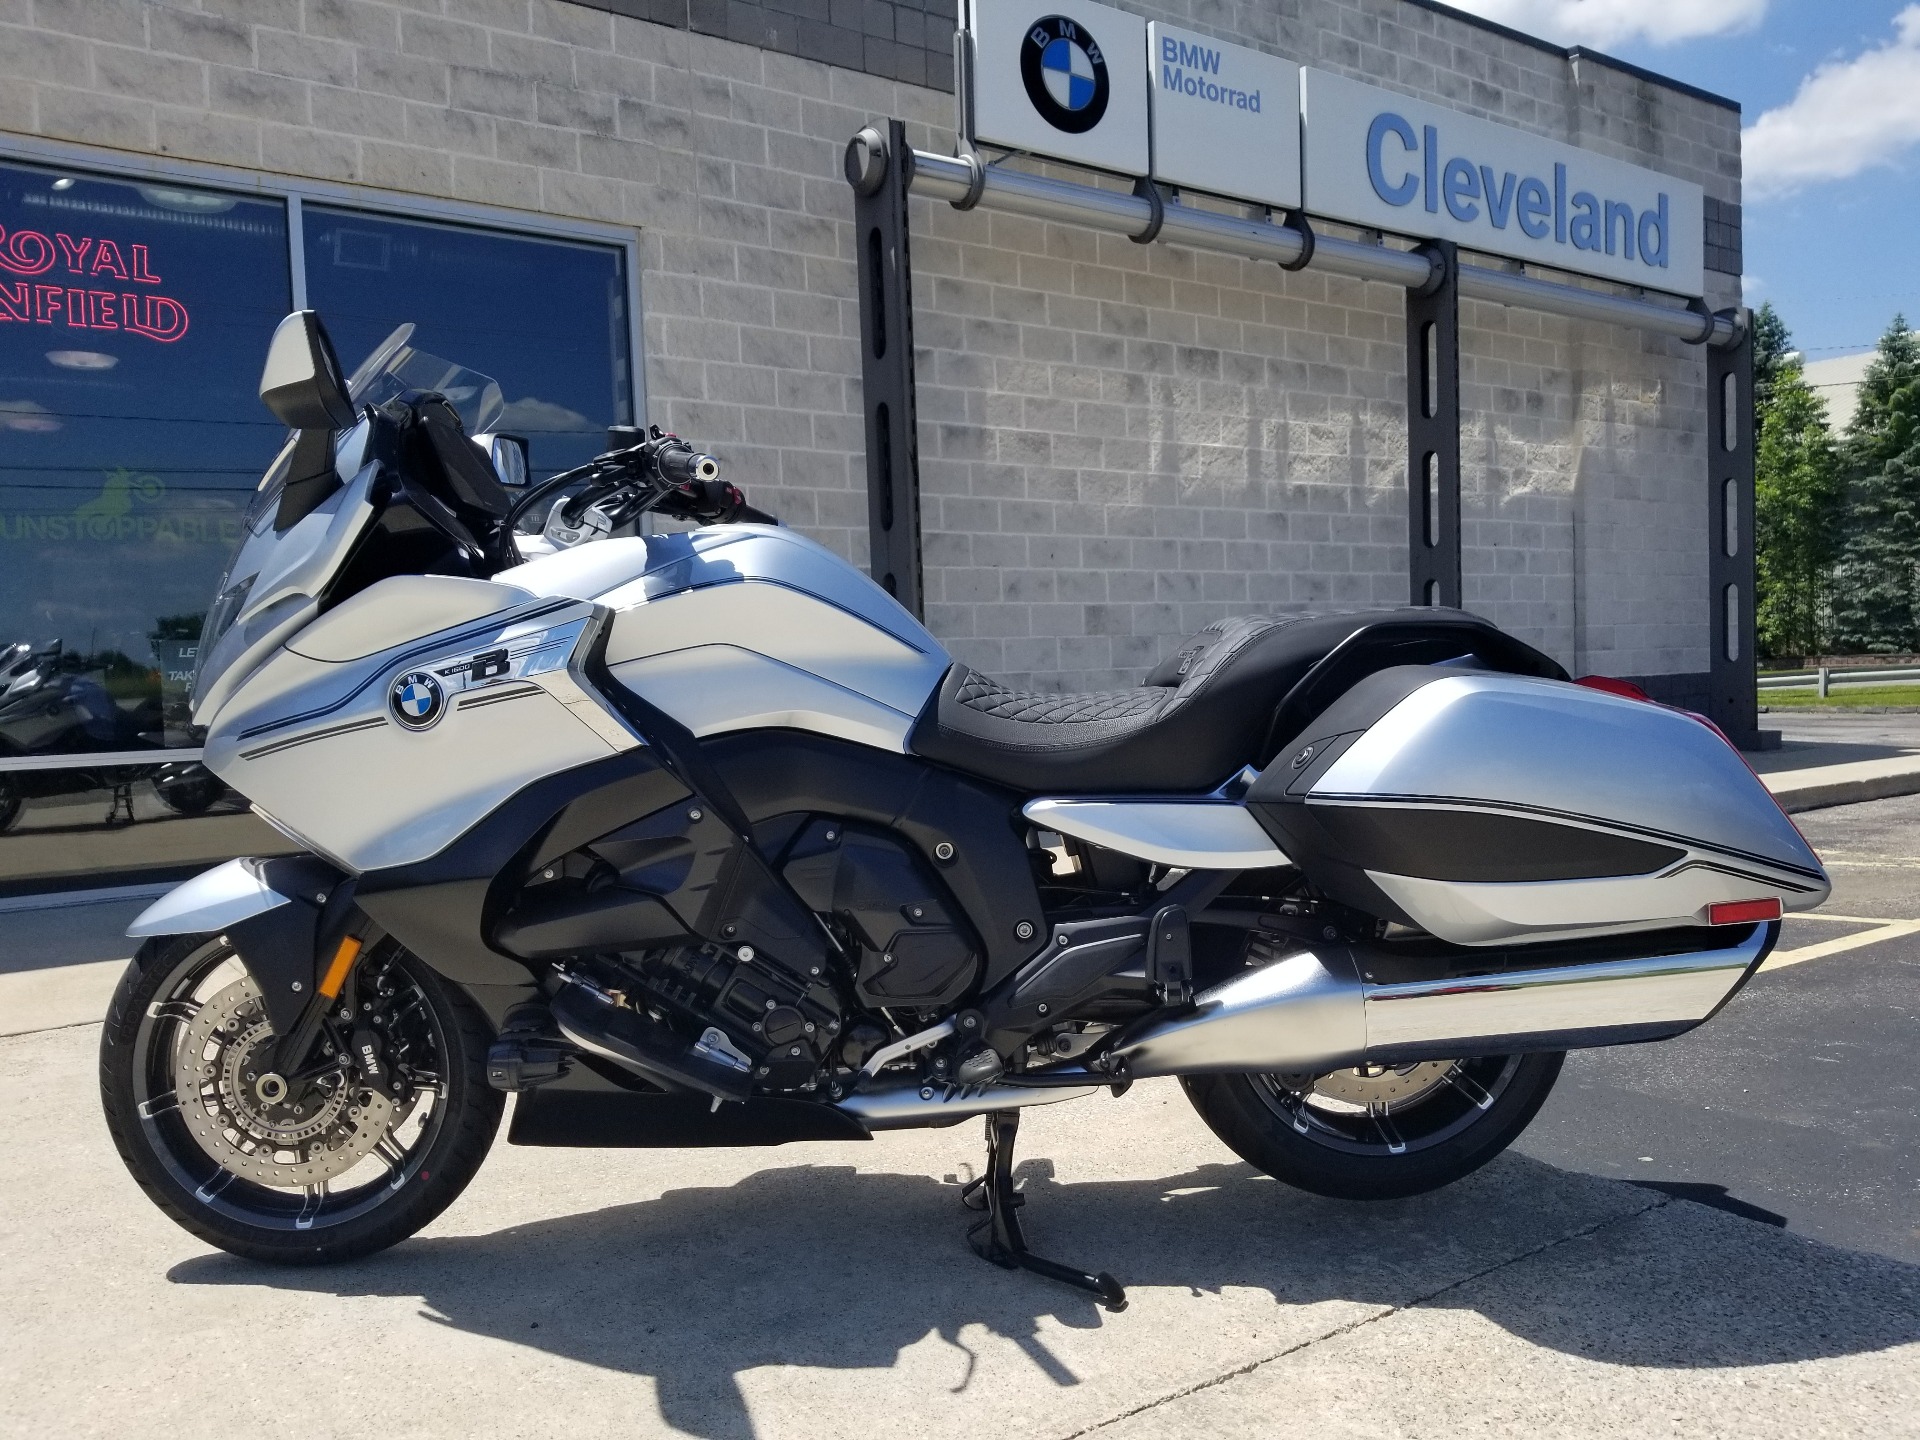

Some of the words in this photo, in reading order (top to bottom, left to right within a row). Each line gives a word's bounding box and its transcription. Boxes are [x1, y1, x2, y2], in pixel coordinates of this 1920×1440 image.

[1030, 19, 1104, 65] BMW
[1161, 36, 1221, 75] BMW
[1162, 65, 1261, 114] Motorrad
[1366, 112, 1669, 268] Cleveland
[0, 283, 190, 342] NFIELD
[0, 515, 241, 545] UNSTOPPABLE
[169, 670, 193, 681] TAK
[395, 675, 435, 695] BMW
[361, 1044, 379, 1074] BMW
